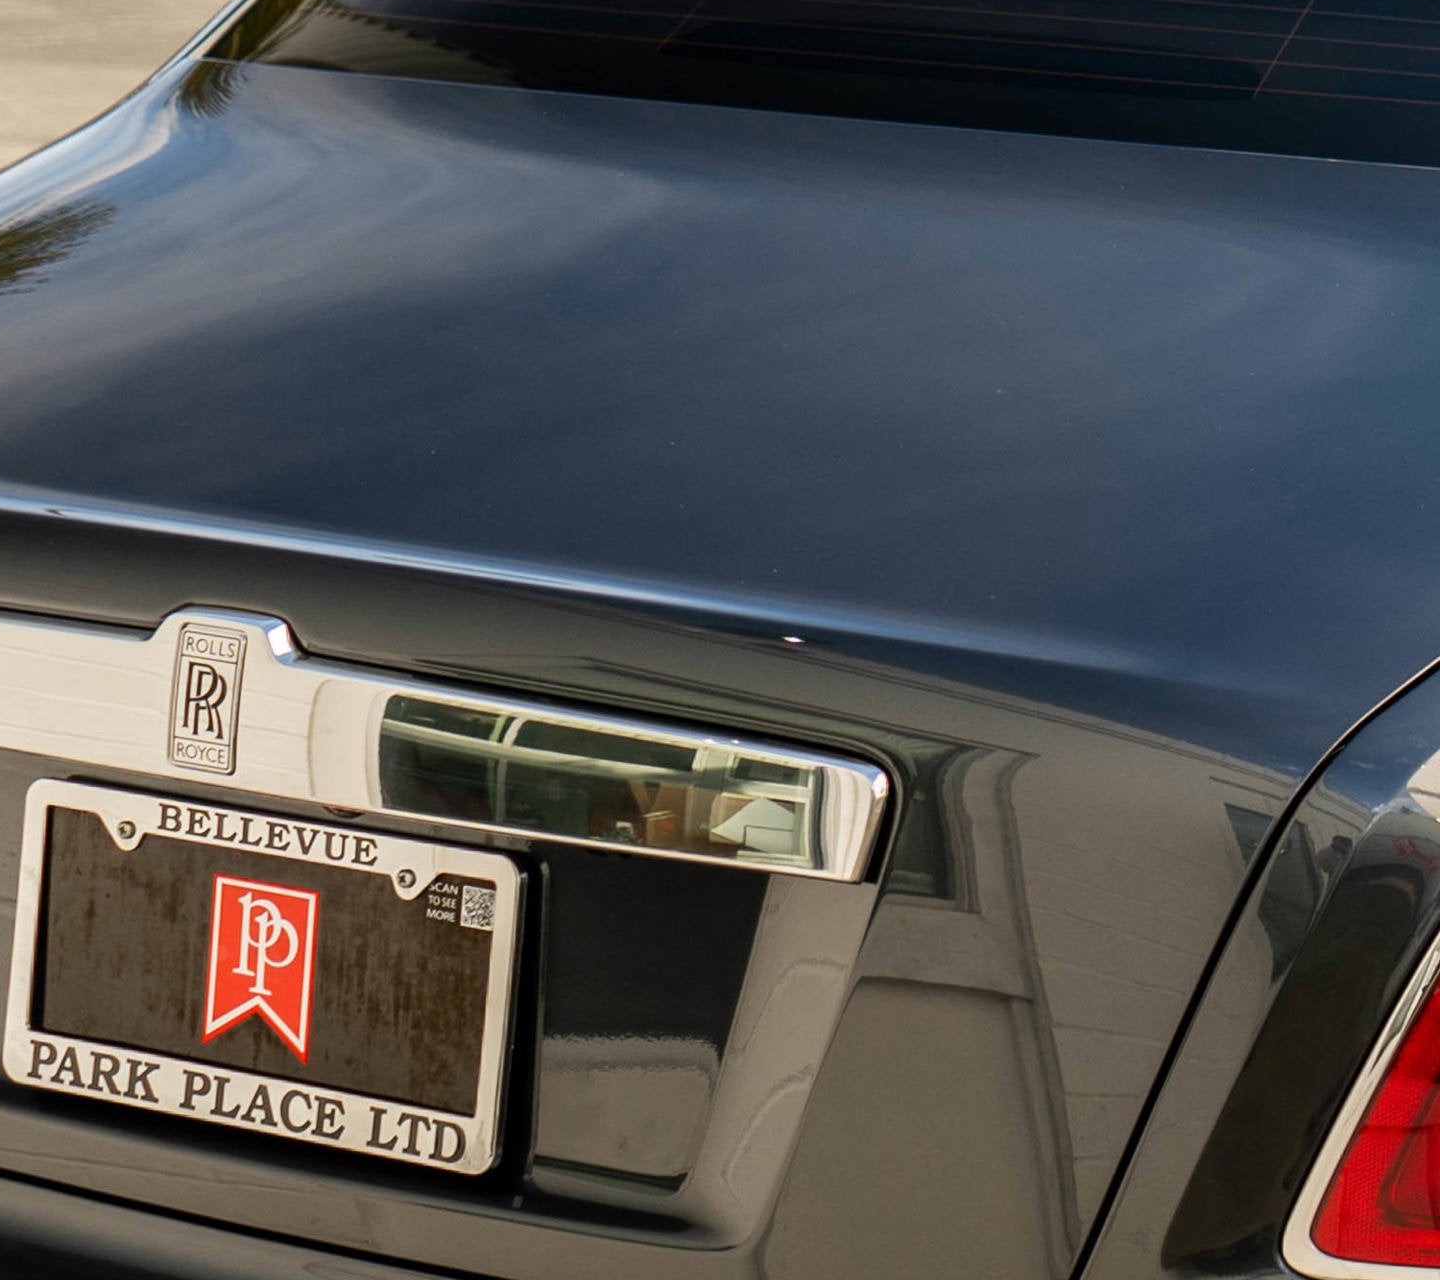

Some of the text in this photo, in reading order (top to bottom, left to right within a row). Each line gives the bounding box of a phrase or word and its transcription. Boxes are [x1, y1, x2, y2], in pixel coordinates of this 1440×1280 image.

[185, 636, 236, 658] ROLLS
[182, 661, 228, 740] RR
[176, 742, 227, 765] ROYCE
[157, 803, 378, 867] BELLEVUE
[428, 894, 457, 909] TO SEE
[426, 908, 456, 922] MORE
[27, 1039, 468, 1164] PARK PLACE LTD
